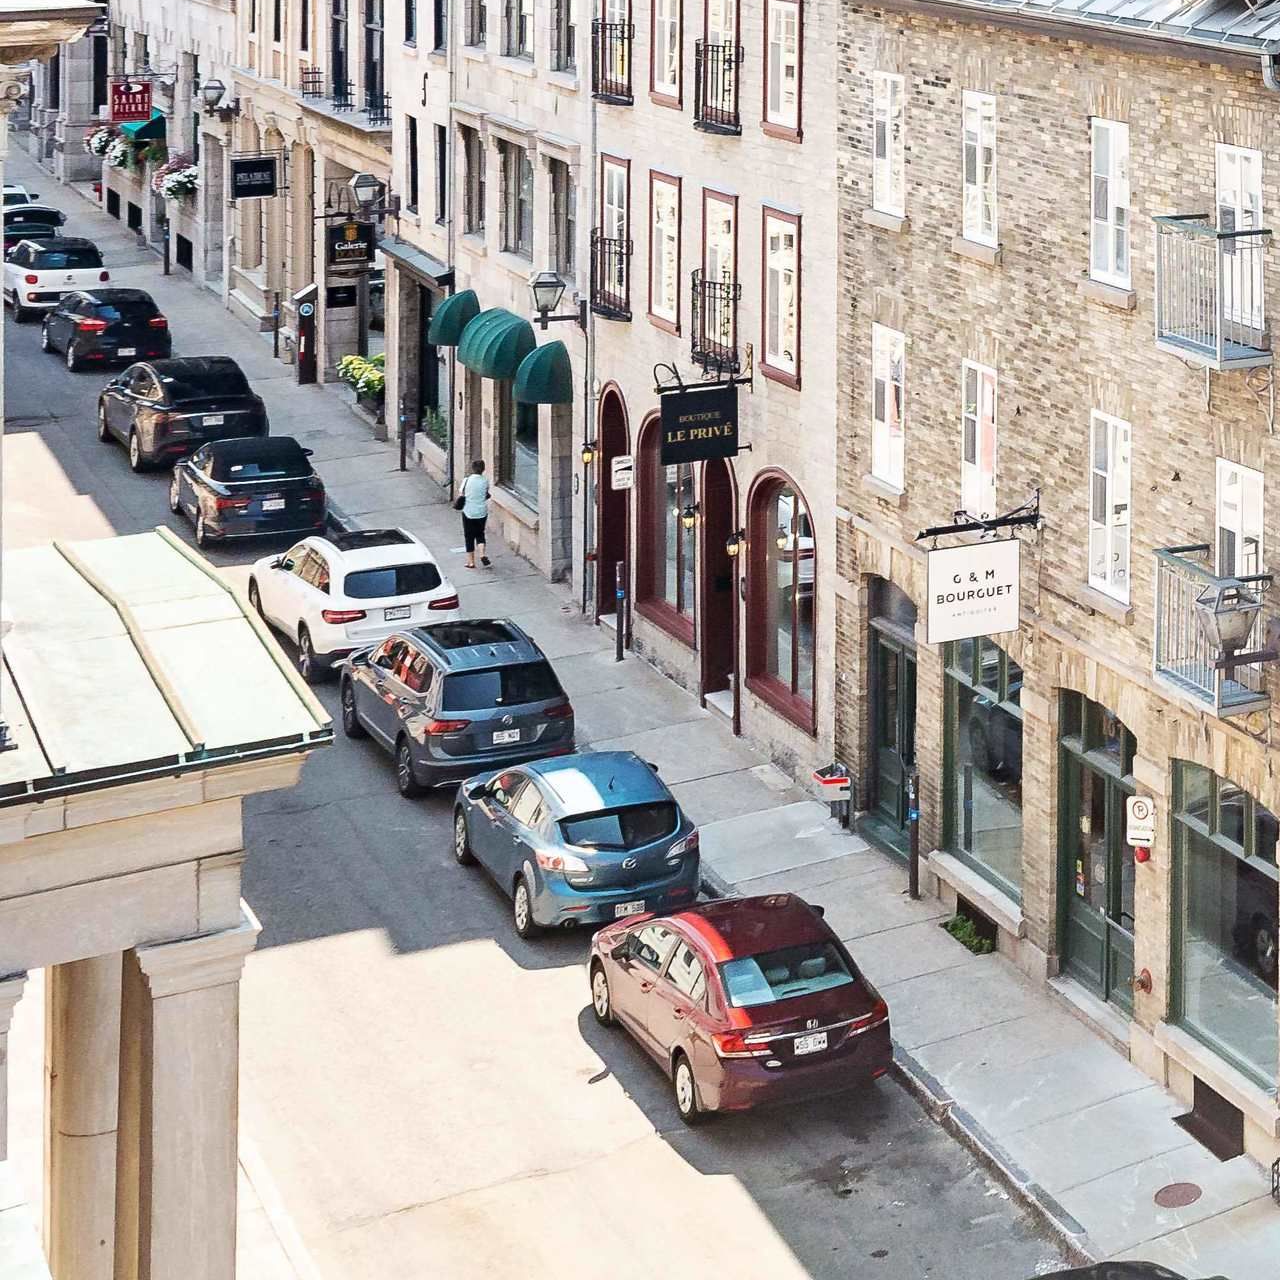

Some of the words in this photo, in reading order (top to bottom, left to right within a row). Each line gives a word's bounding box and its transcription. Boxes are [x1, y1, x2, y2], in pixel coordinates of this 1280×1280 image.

[113, 94, 149, 104] SAINT
[113, 103, 149, 112] PIERRE
[334, 241, 368, 250] Galerie
[679, 411, 720, 423] BOUTIQUE
[667, 430, 686, 443] LE
[689, 421, 733, 440] PRIVÉ
[953, 574, 962, 584] G
[969, 572, 978, 583] &
[985, 569, 995, 580] M
[936, 584, 1013, 605] BOURGUET
